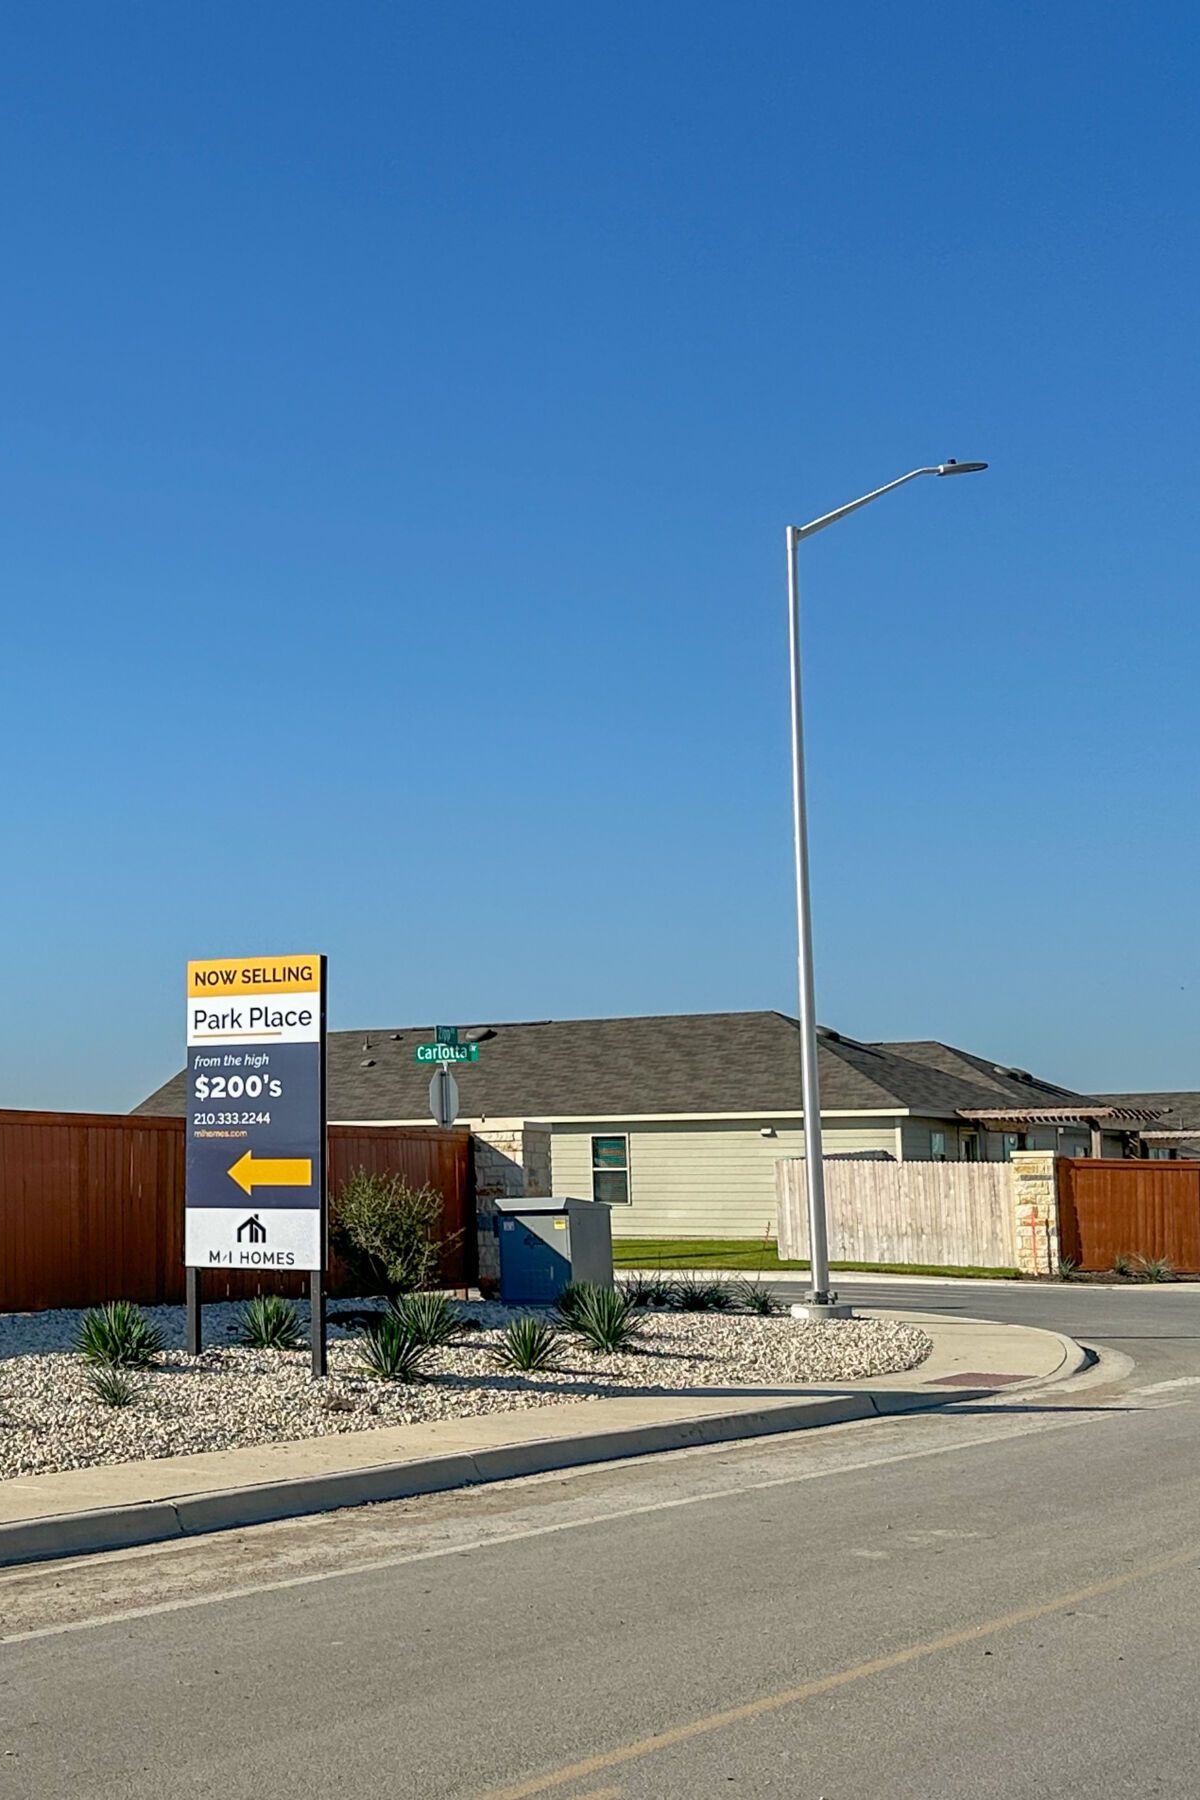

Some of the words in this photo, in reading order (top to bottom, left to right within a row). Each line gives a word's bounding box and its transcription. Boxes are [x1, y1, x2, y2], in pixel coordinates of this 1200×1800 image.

[195, 970, 237, 986] NOW
[241, 966, 312, 983] SELLING
[194, 1008, 242, 1029] Park
[250, 1006, 312, 1028] Place
[417, 1044, 468, 1060] Carlotta
[194, 1055, 220, 1069] from
[224, 1054, 241, 1066] the
[244, 1053, 269, 1068] high
[194, 1074, 282, 1101] $200's
[193, 1112, 271, 1125] 210.333.2244
[193, 1129, 248, 1138] mihomes.com
[240, 1251, 295, 1265] HOMES
